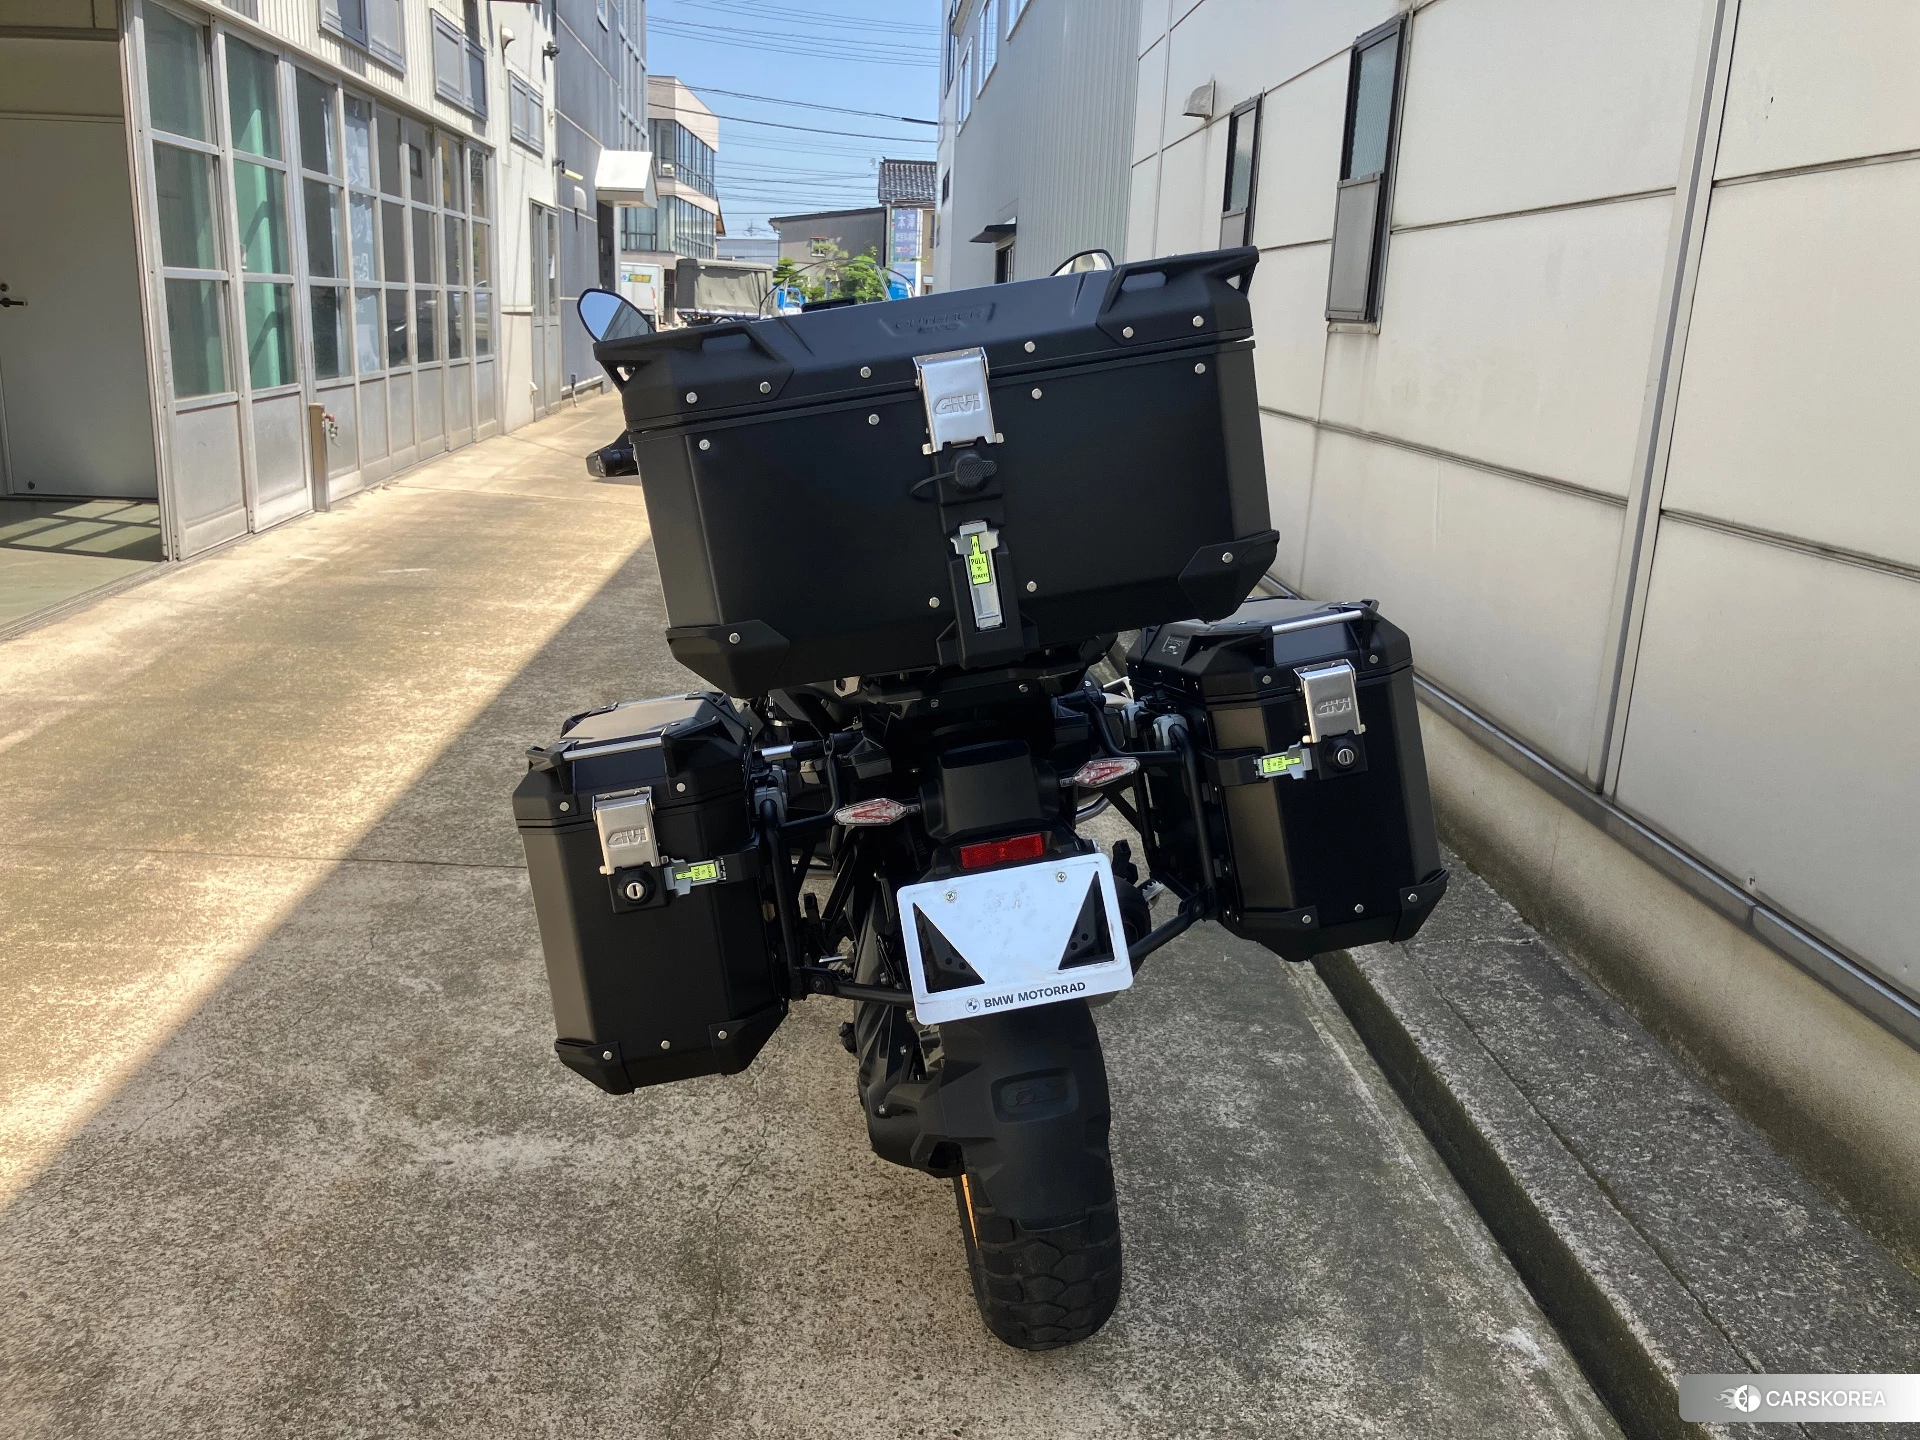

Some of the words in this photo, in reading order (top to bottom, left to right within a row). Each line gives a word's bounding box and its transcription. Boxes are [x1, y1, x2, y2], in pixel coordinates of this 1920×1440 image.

[934, 394, 982, 415] GIVI
[970, 557, 985, 565] PULL
[1315, 697, 1351, 716] GIVI
[608, 827, 648, 847] GIVI
[984, 994, 1014, 1008] BMW
[1018, 982, 1086, 1001] MOTORRAD
